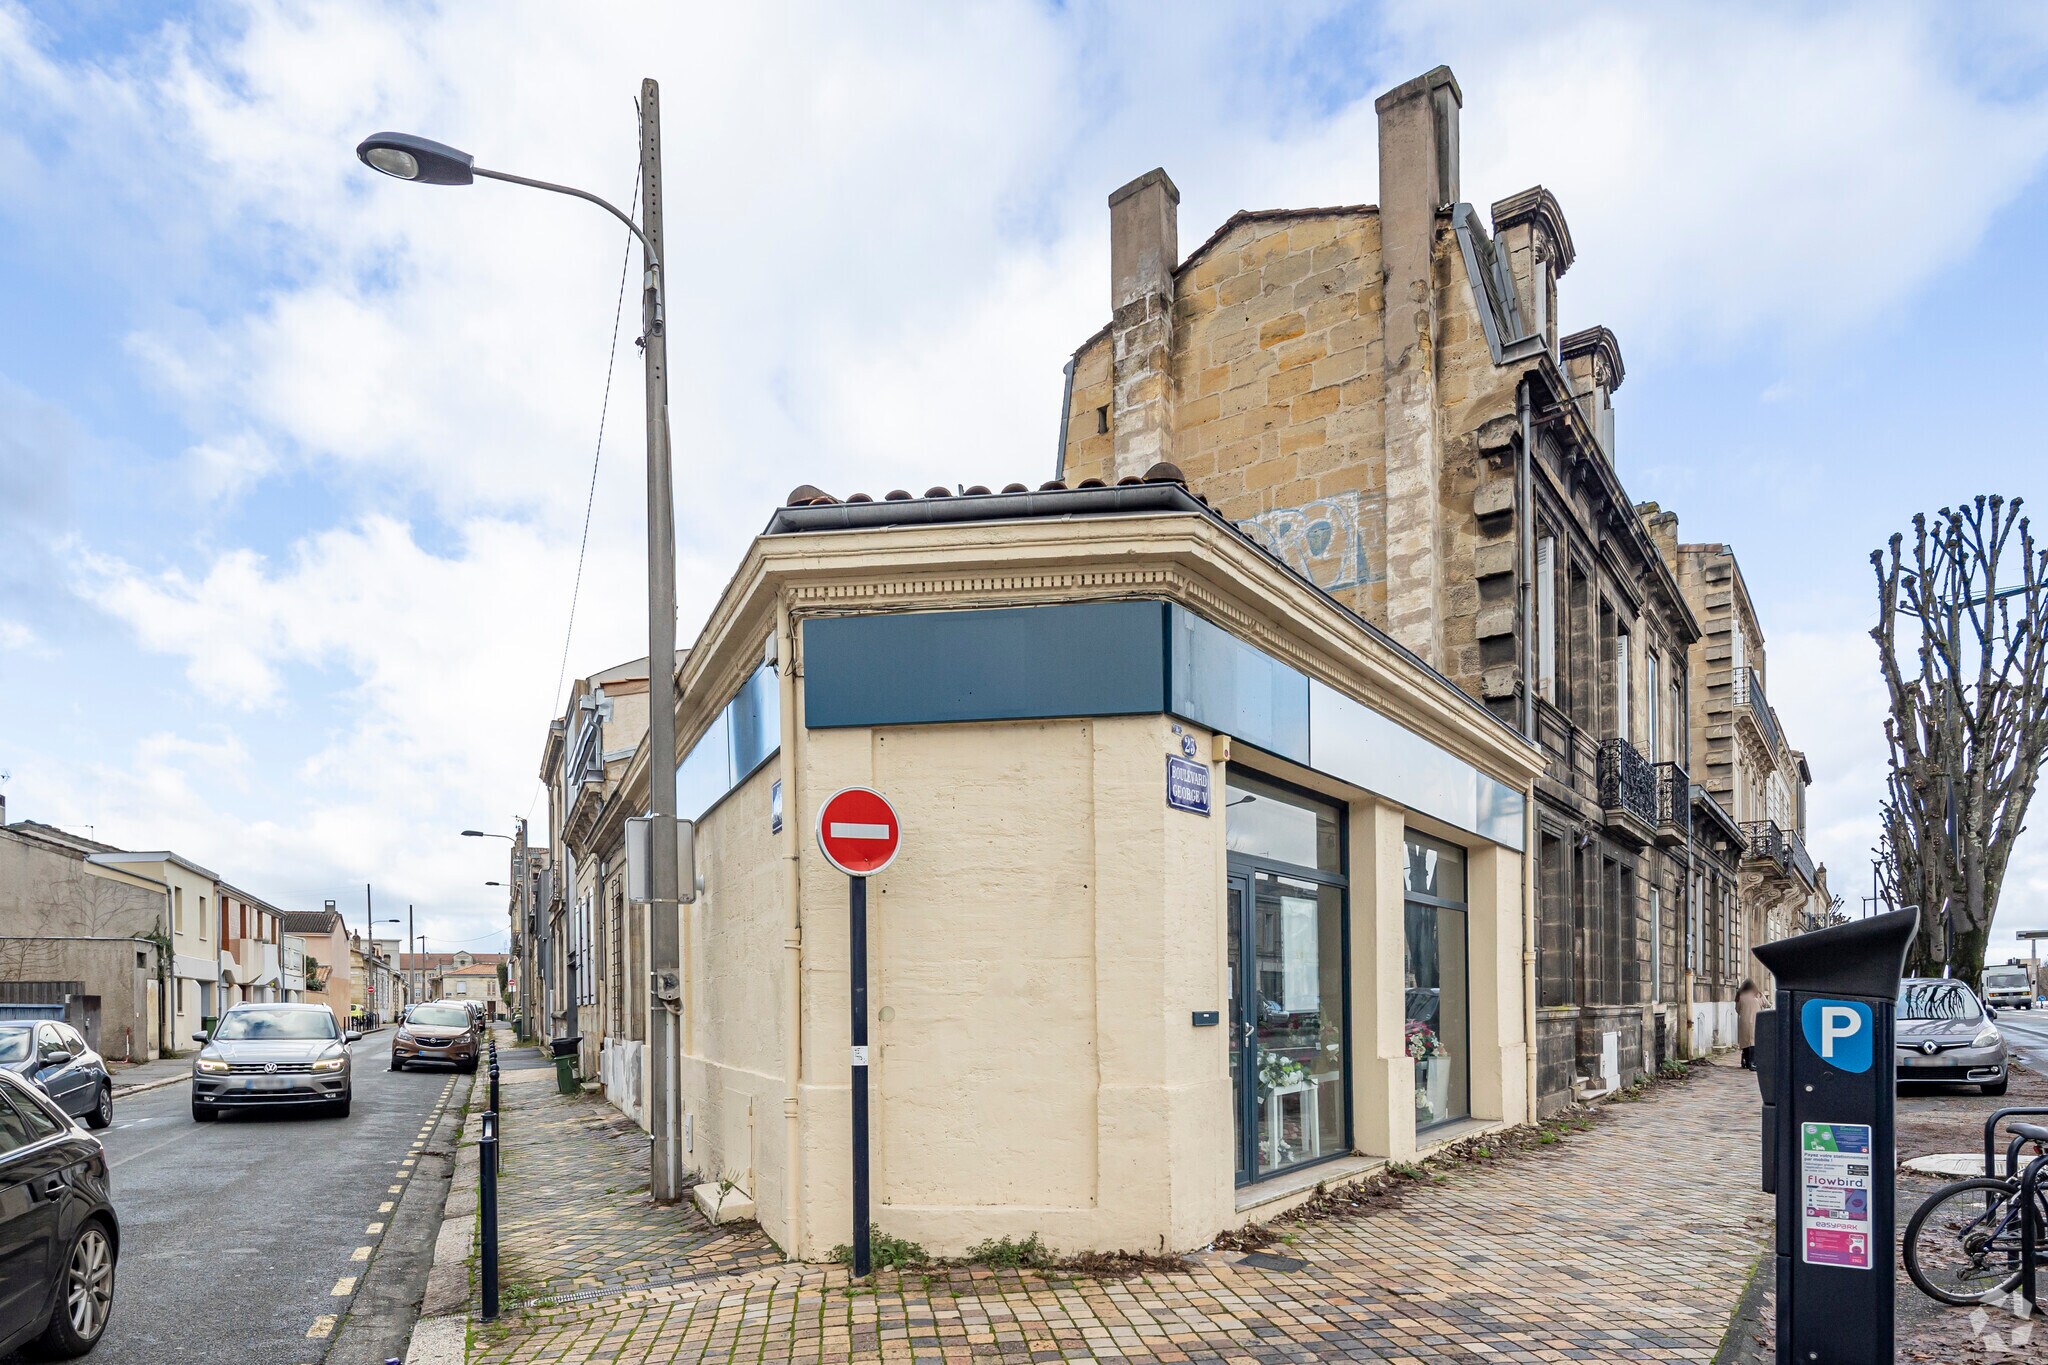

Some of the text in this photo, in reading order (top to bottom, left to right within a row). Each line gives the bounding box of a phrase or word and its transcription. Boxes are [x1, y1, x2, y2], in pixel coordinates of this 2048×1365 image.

[1171, 765, 1207, 787] BOULEVARD
[1172, 784, 1208, 805] GEORGE V
[1821, 1006, 1862, 1058] P
[1808, 1175, 1863, 1188] flowbird
